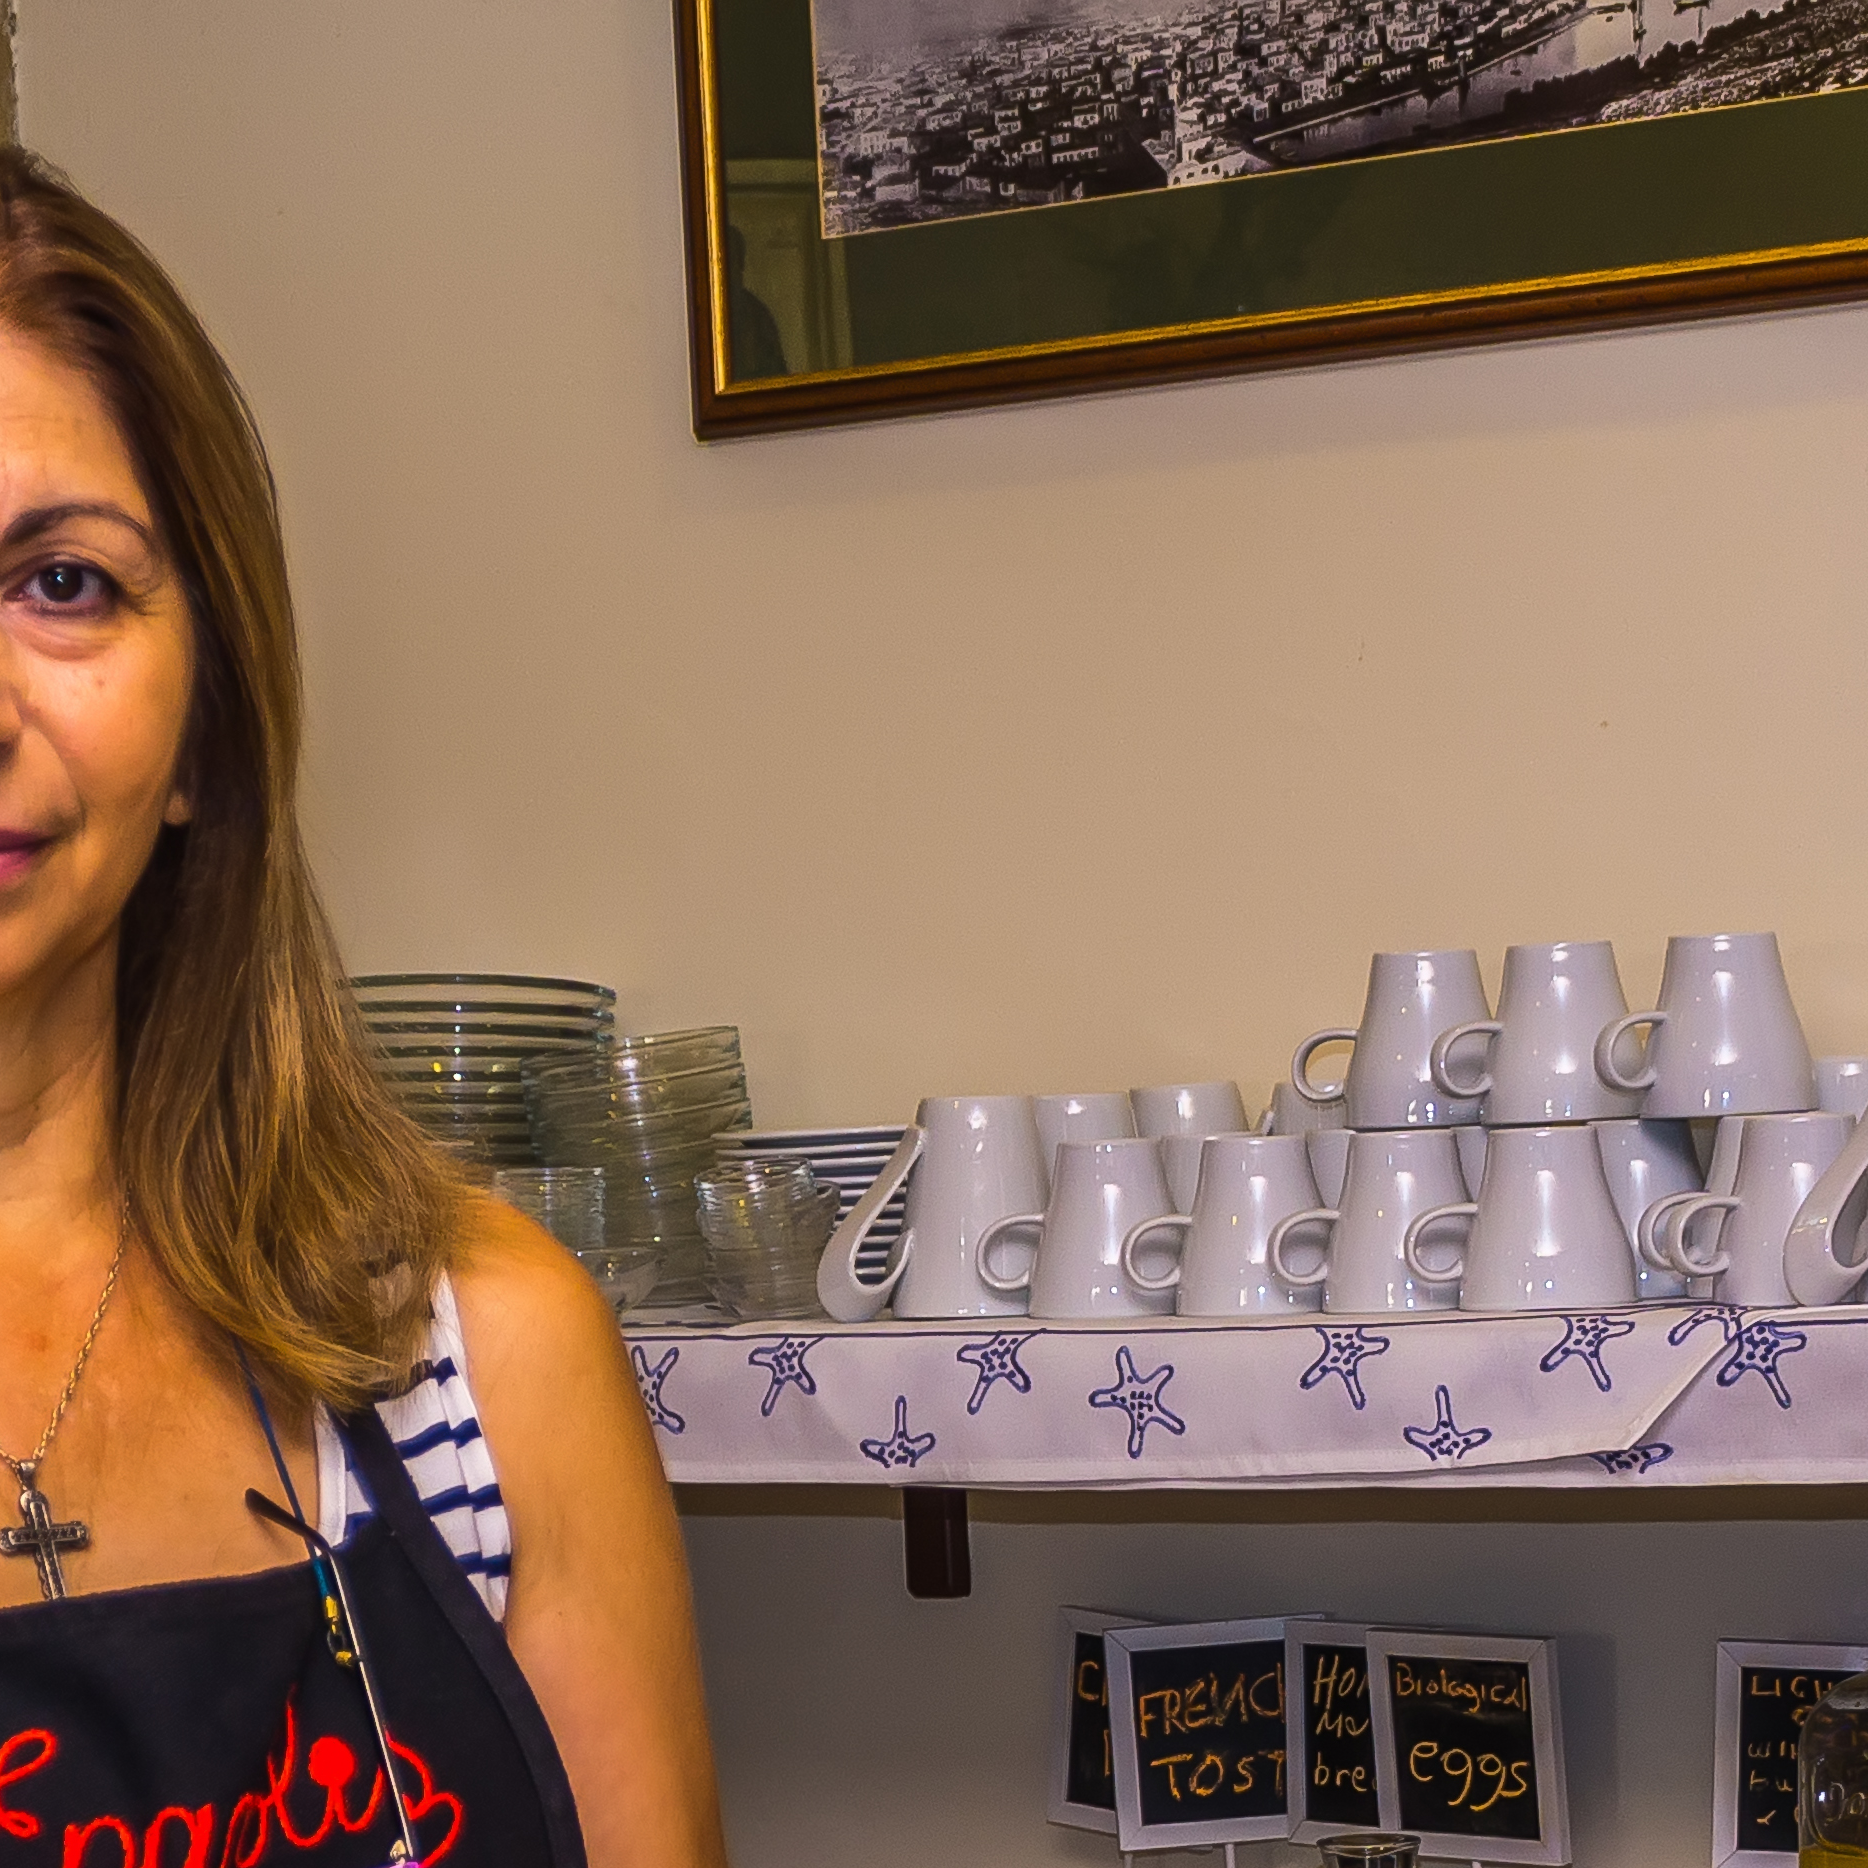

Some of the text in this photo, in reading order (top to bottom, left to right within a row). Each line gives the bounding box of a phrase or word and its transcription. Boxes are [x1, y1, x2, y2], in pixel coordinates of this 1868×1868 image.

[1314, 1655, 1369, 1710] Ho
[1314, 1751, 1378, 1793] bre
[1410, 1741, 1529, 1811] eggs
